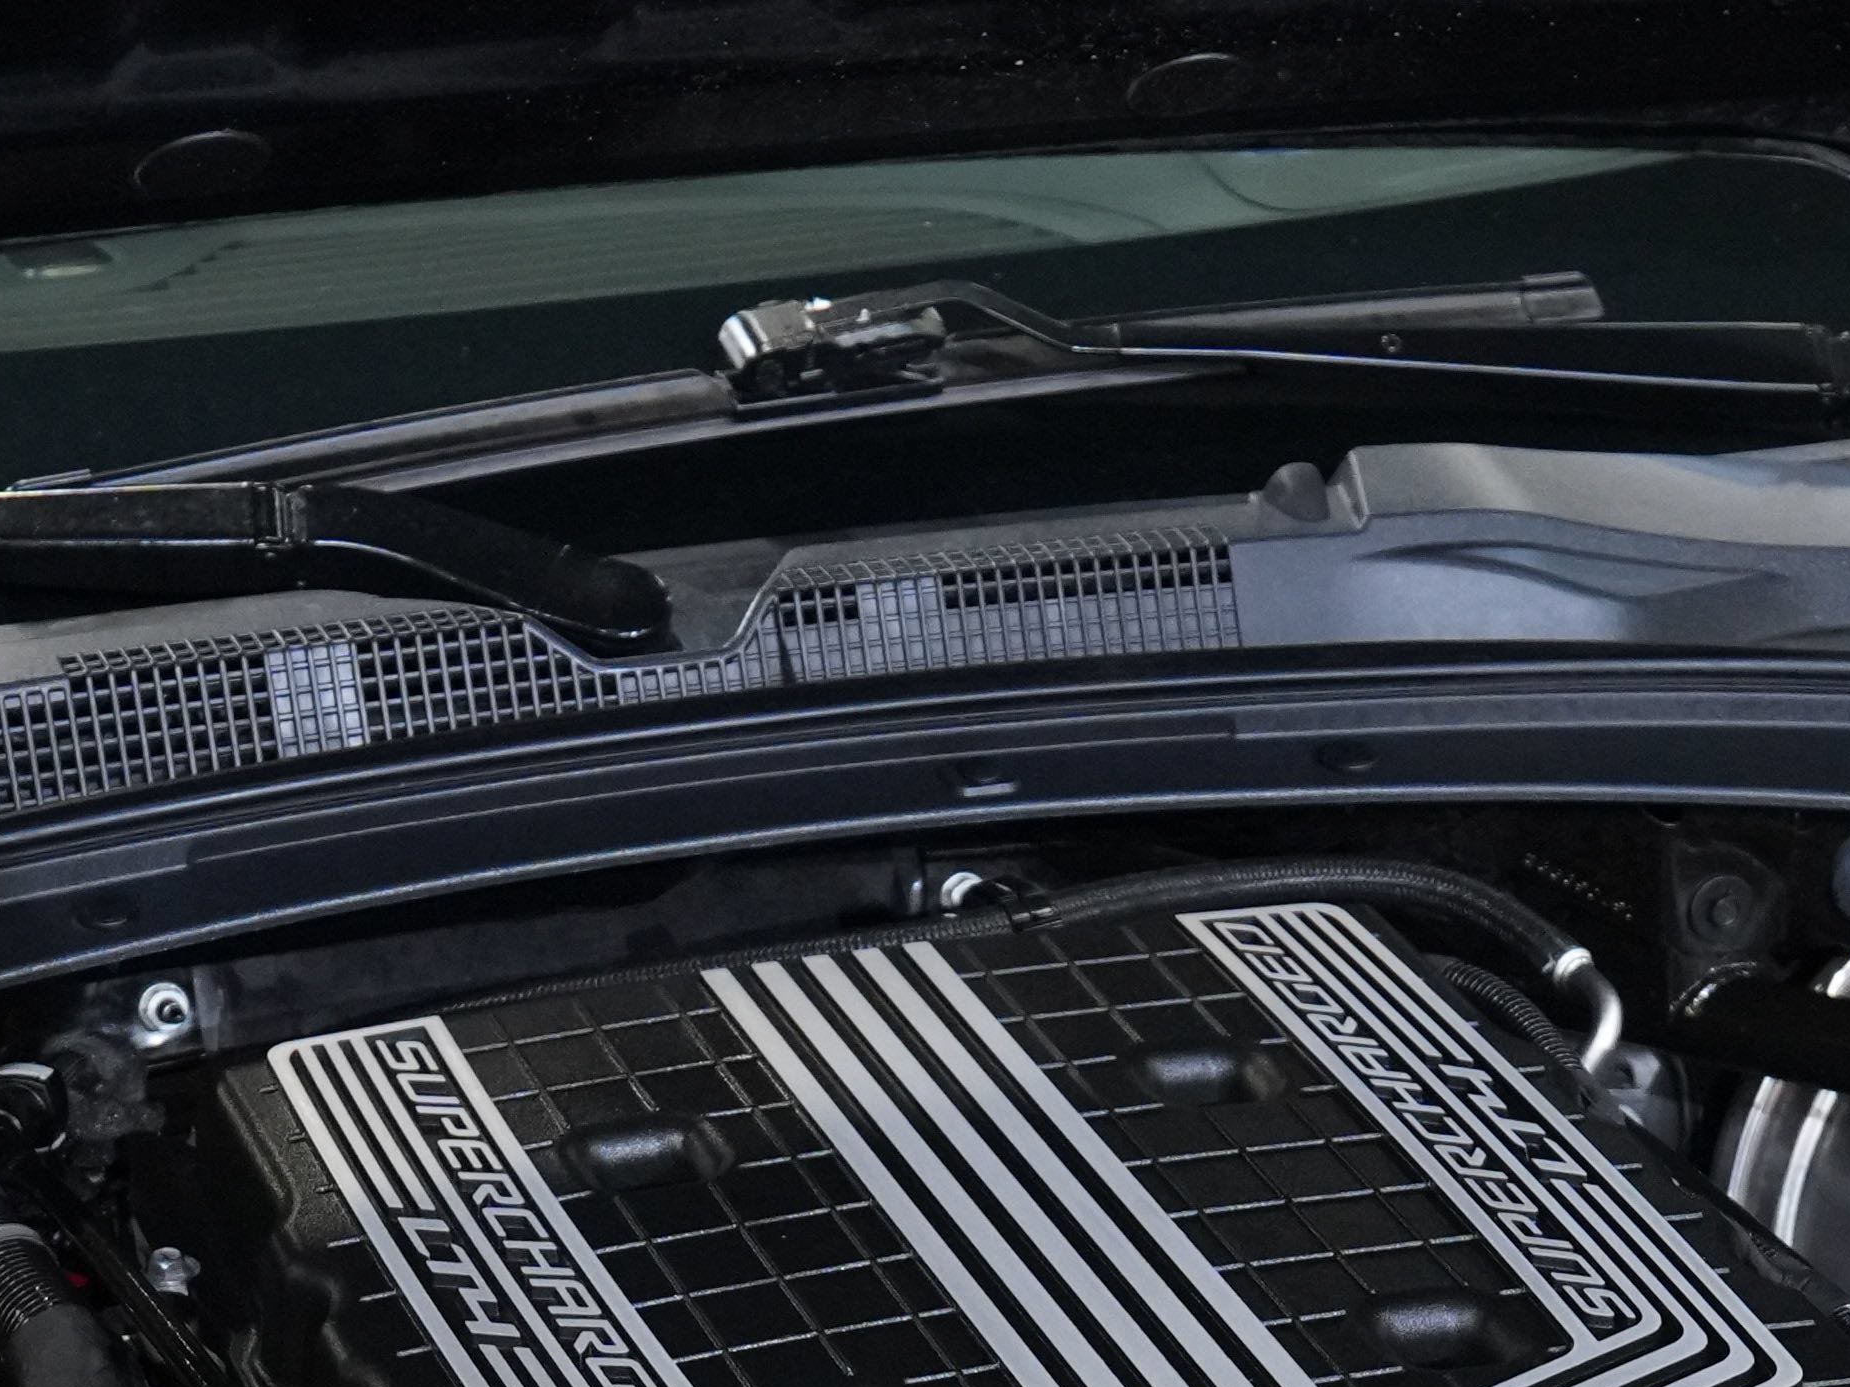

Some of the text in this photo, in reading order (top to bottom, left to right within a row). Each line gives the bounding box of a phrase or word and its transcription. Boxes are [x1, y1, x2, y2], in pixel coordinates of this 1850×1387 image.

[1216, 919, 1635, 1328] SUPERCHARGED
[1438, 1062, 1589, 1184] LT4
[398, 1215, 521, 1342] LT4
